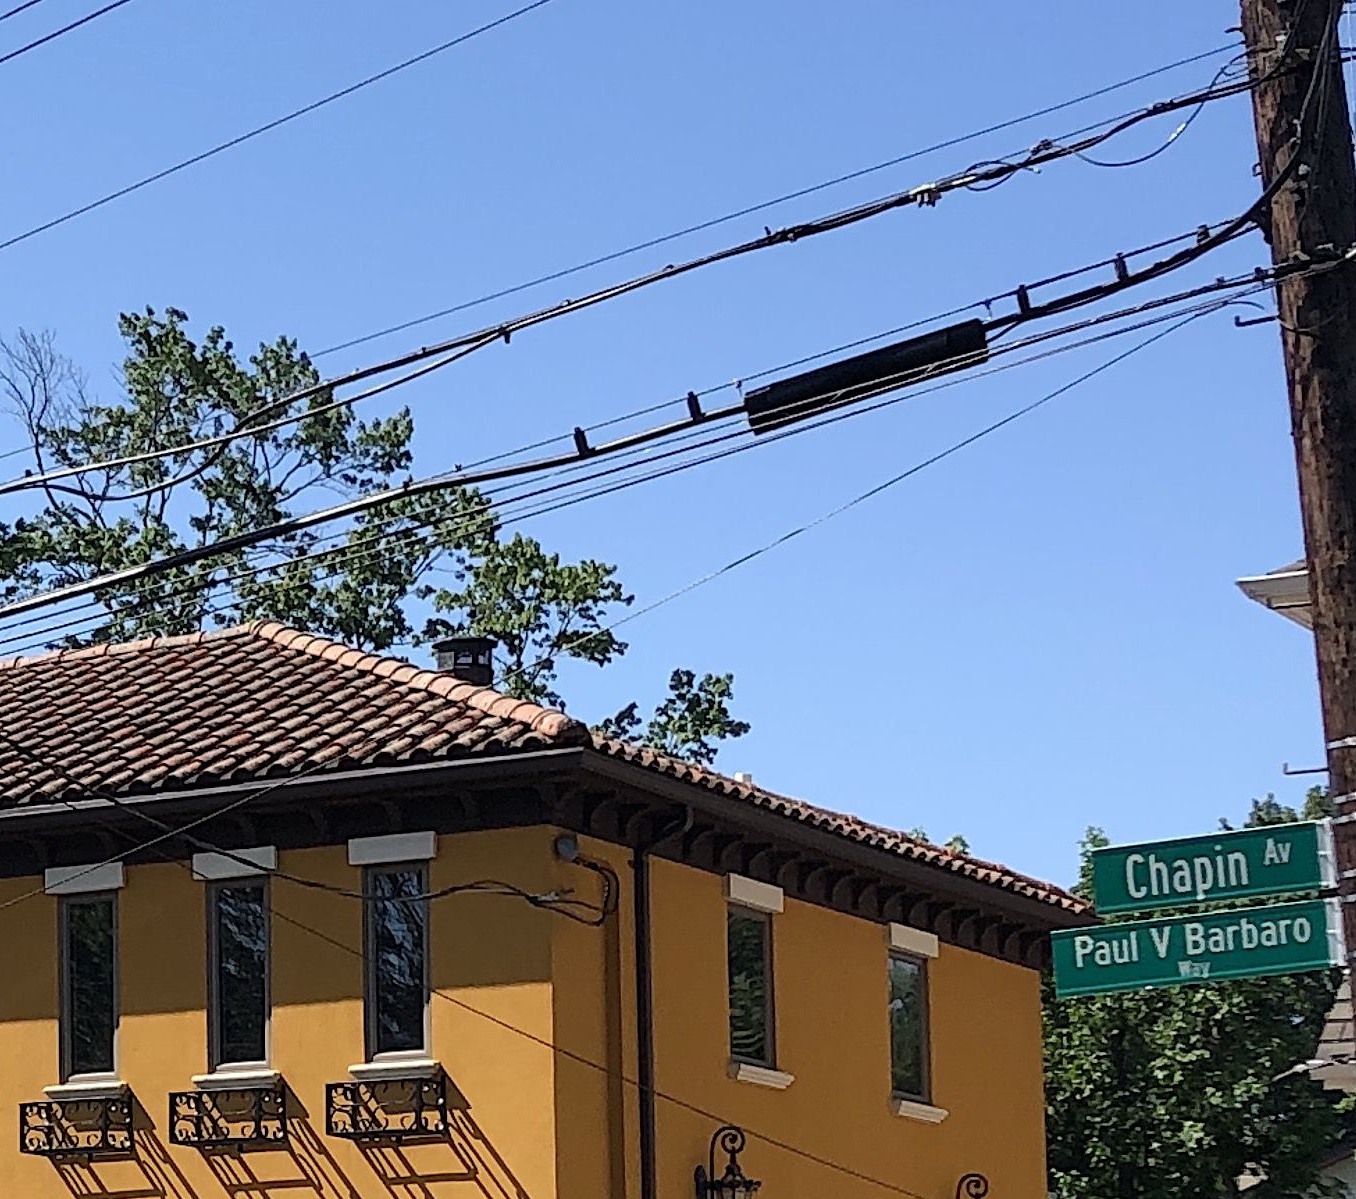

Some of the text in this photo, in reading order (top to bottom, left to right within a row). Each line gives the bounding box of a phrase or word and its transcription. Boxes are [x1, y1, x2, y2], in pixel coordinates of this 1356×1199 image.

[1126, 838, 1292, 900] Chapin Av
[1074, 917, 1312, 968] Paul V Barbaro
